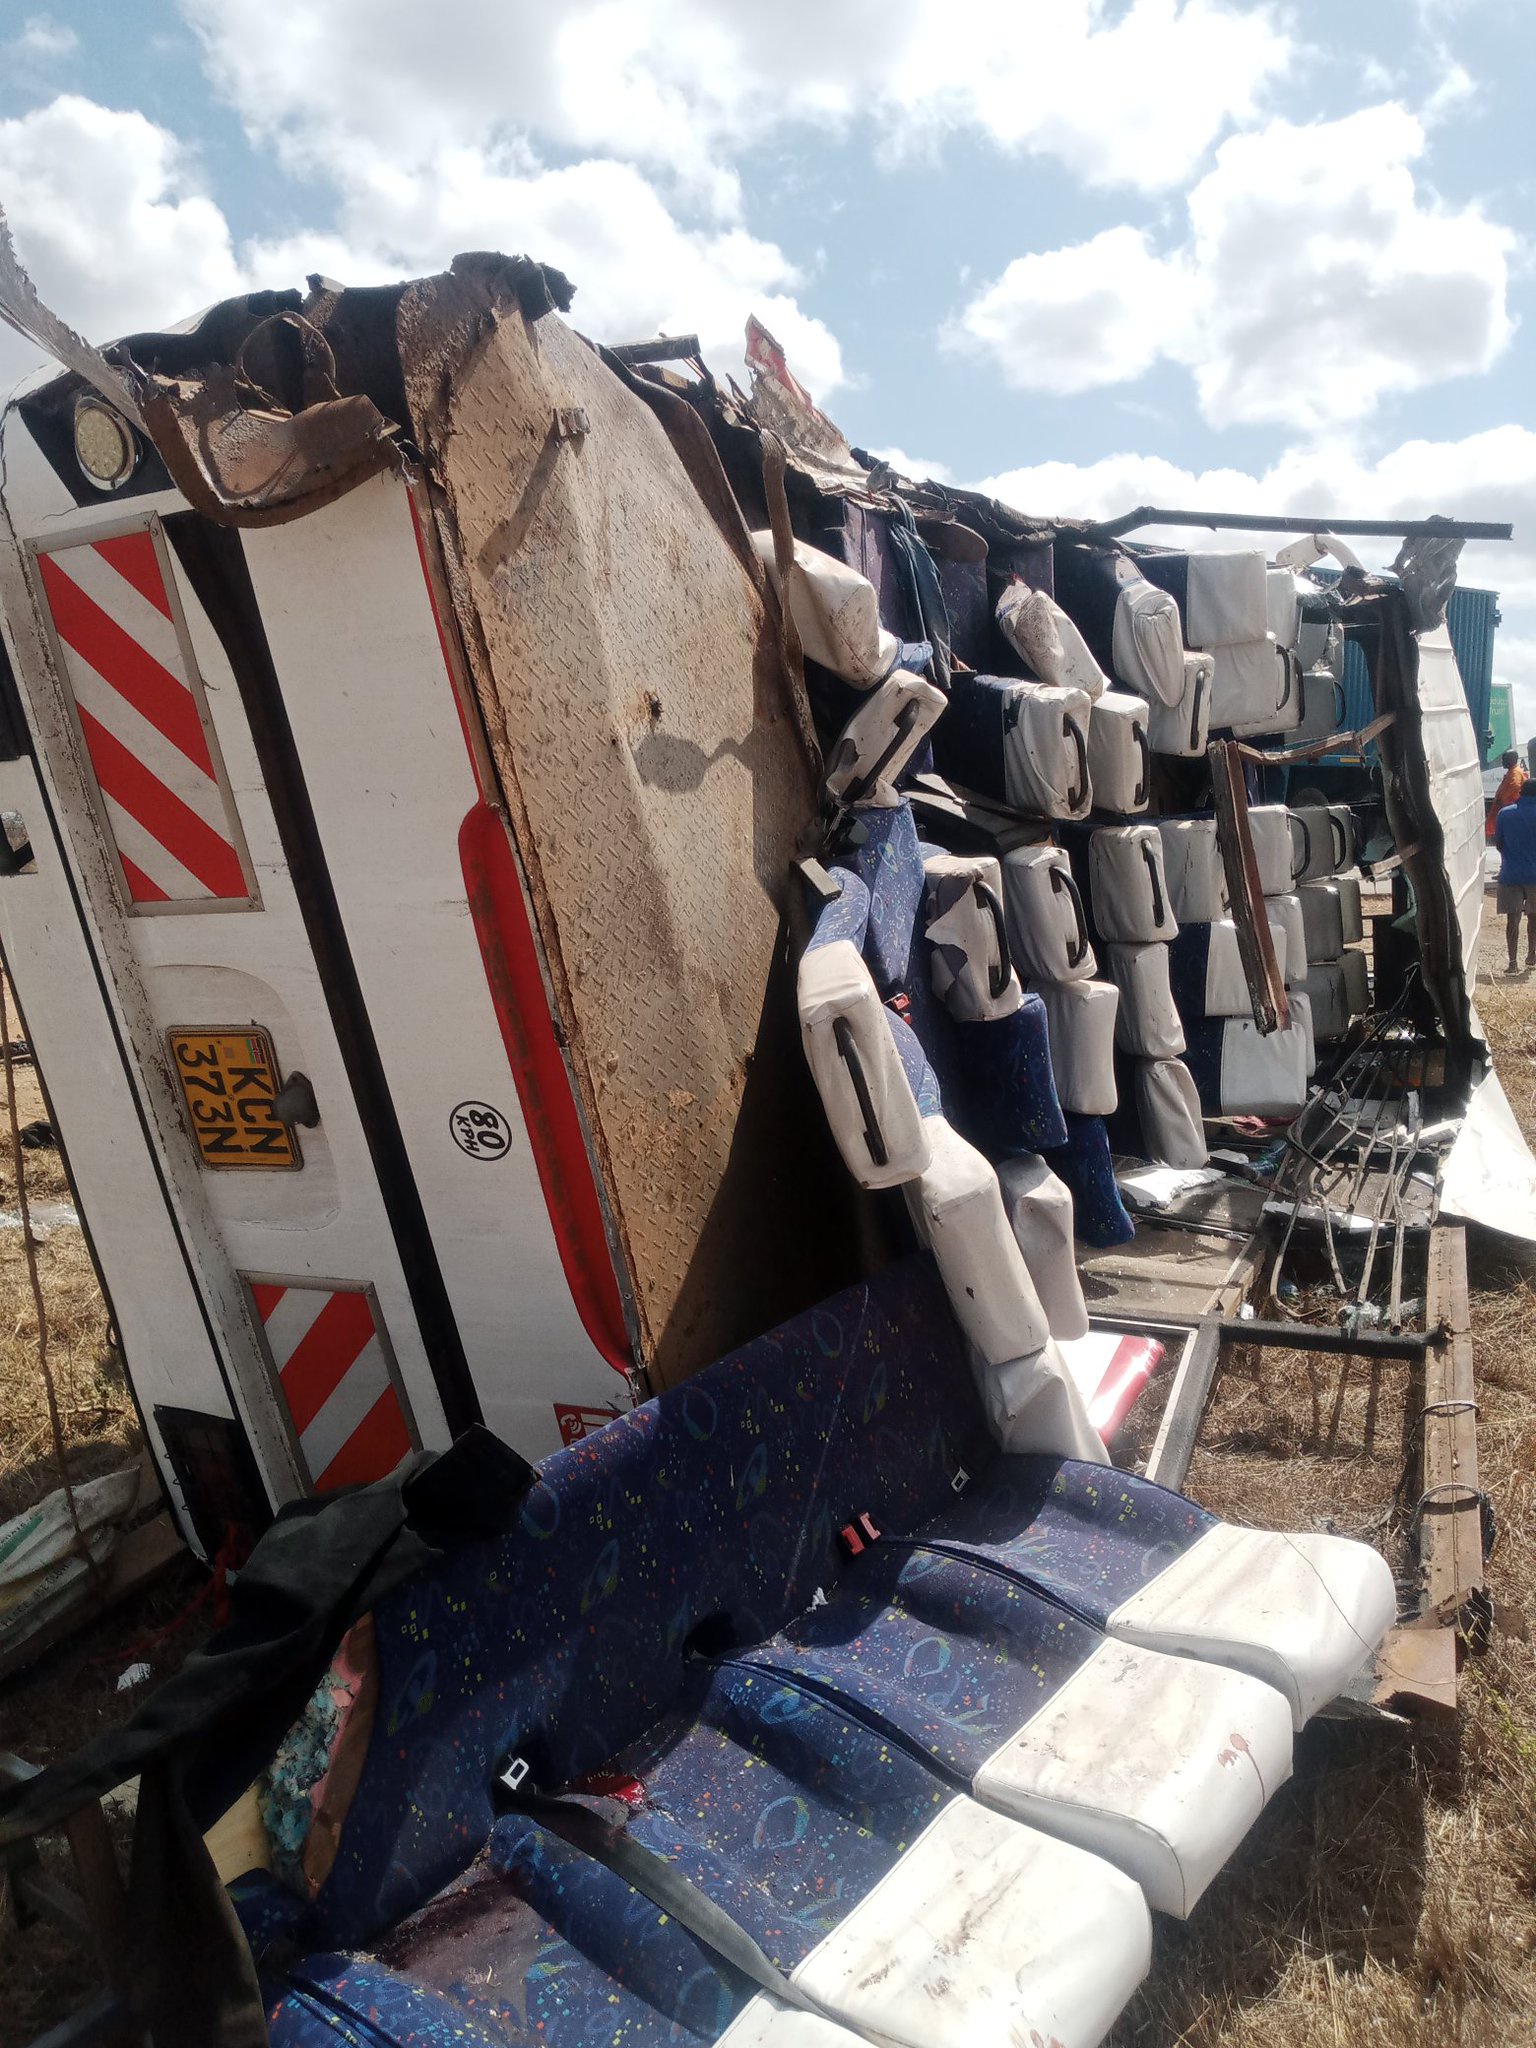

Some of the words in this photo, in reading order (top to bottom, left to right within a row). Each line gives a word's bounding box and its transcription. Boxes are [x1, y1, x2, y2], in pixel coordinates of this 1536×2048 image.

[177, 1043, 244, 1153] 373N
[228, 1067, 289, 1153] KCN
[456, 1115, 480, 1152] KPH
[469, 1110, 505, 1149] 80
